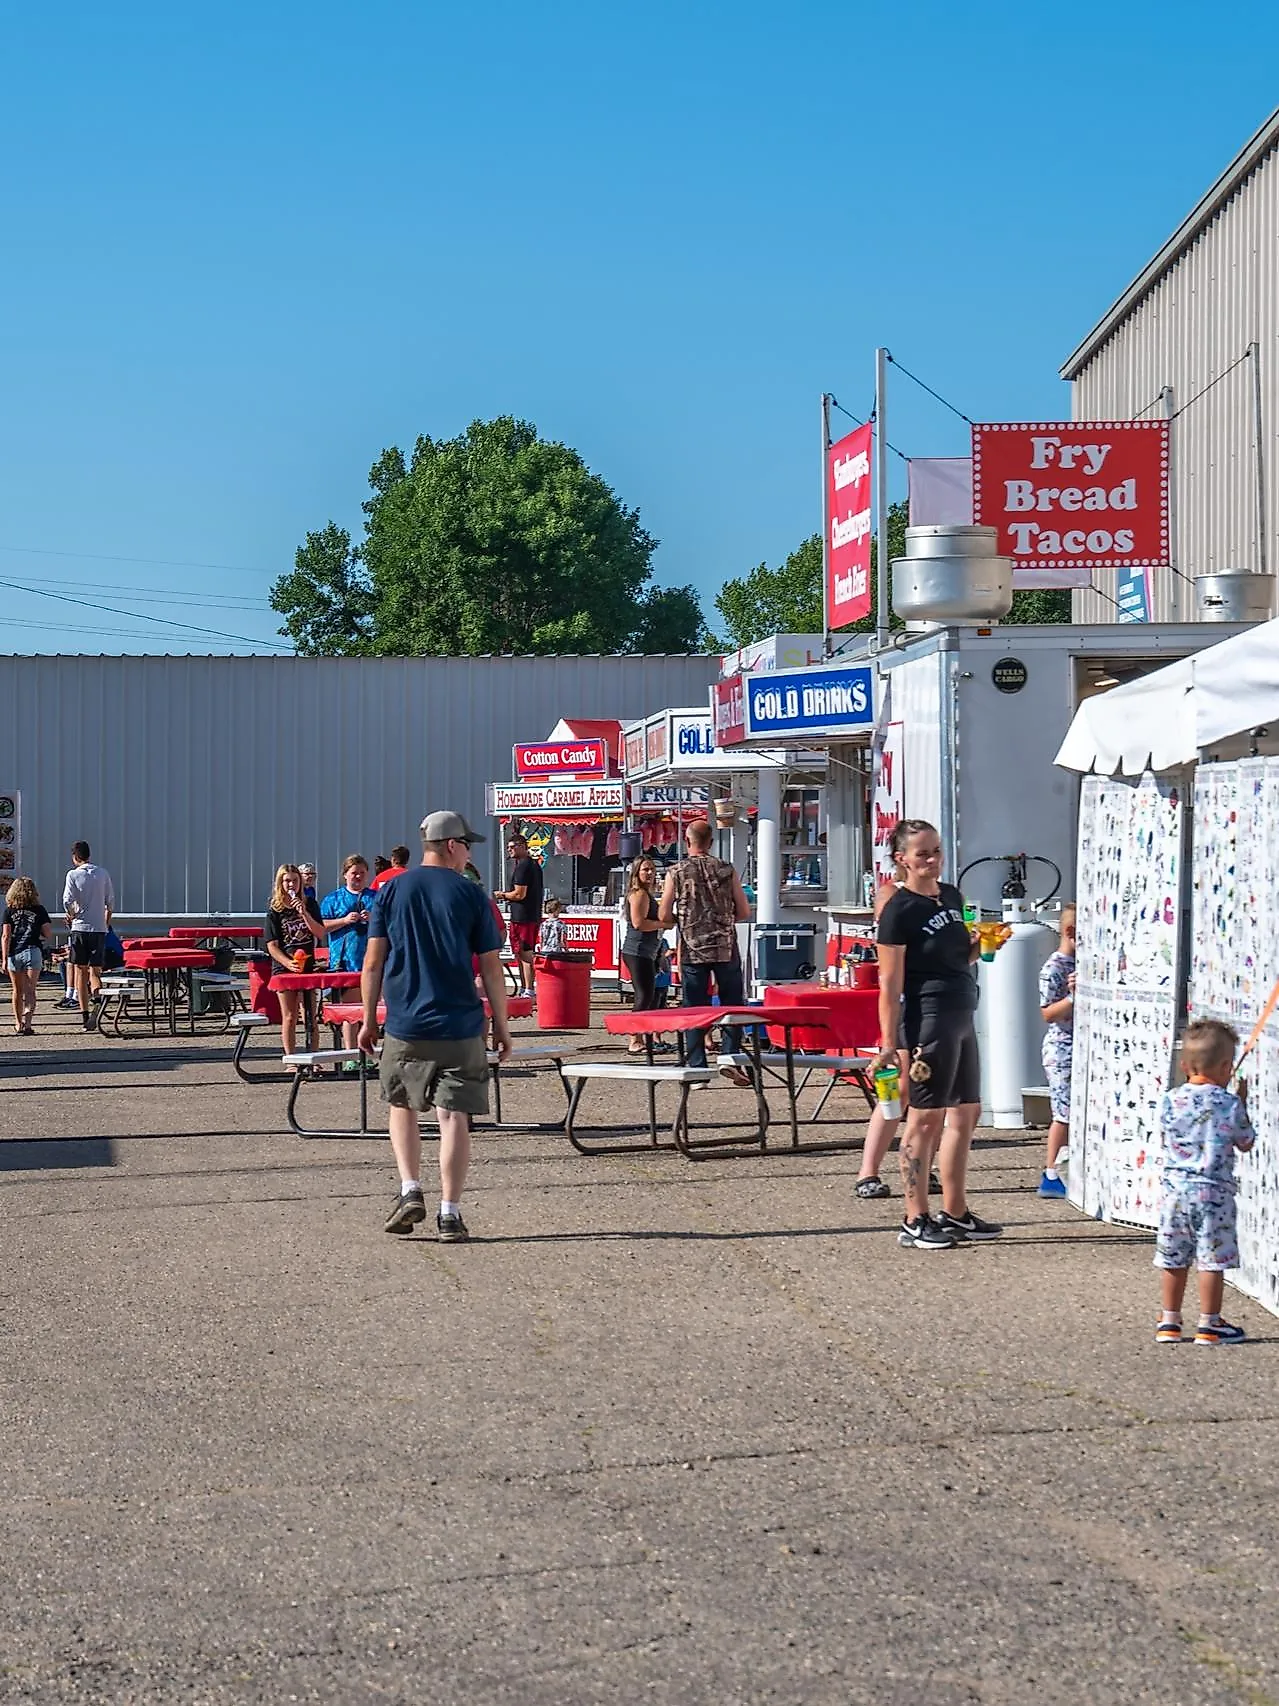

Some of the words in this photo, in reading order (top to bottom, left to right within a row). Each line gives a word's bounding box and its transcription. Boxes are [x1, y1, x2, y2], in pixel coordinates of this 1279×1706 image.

[1030, 436, 1112, 475] Fry
[1003, 478, 1138, 512] Bread
[1007, 522, 1135, 555] Tacos
[754, 686, 799, 721] COLD
[802, 679, 868, 717] DRINKS
[678, 724, 715, 755] COLD
[523, 750, 560, 767] Cotton
[561, 746, 597, 766] Candy
[496, 790, 543, 809] HOMEMADE
[546, 788, 588, 807] CARAMEL
[588, 787, 621, 806] APPLES
